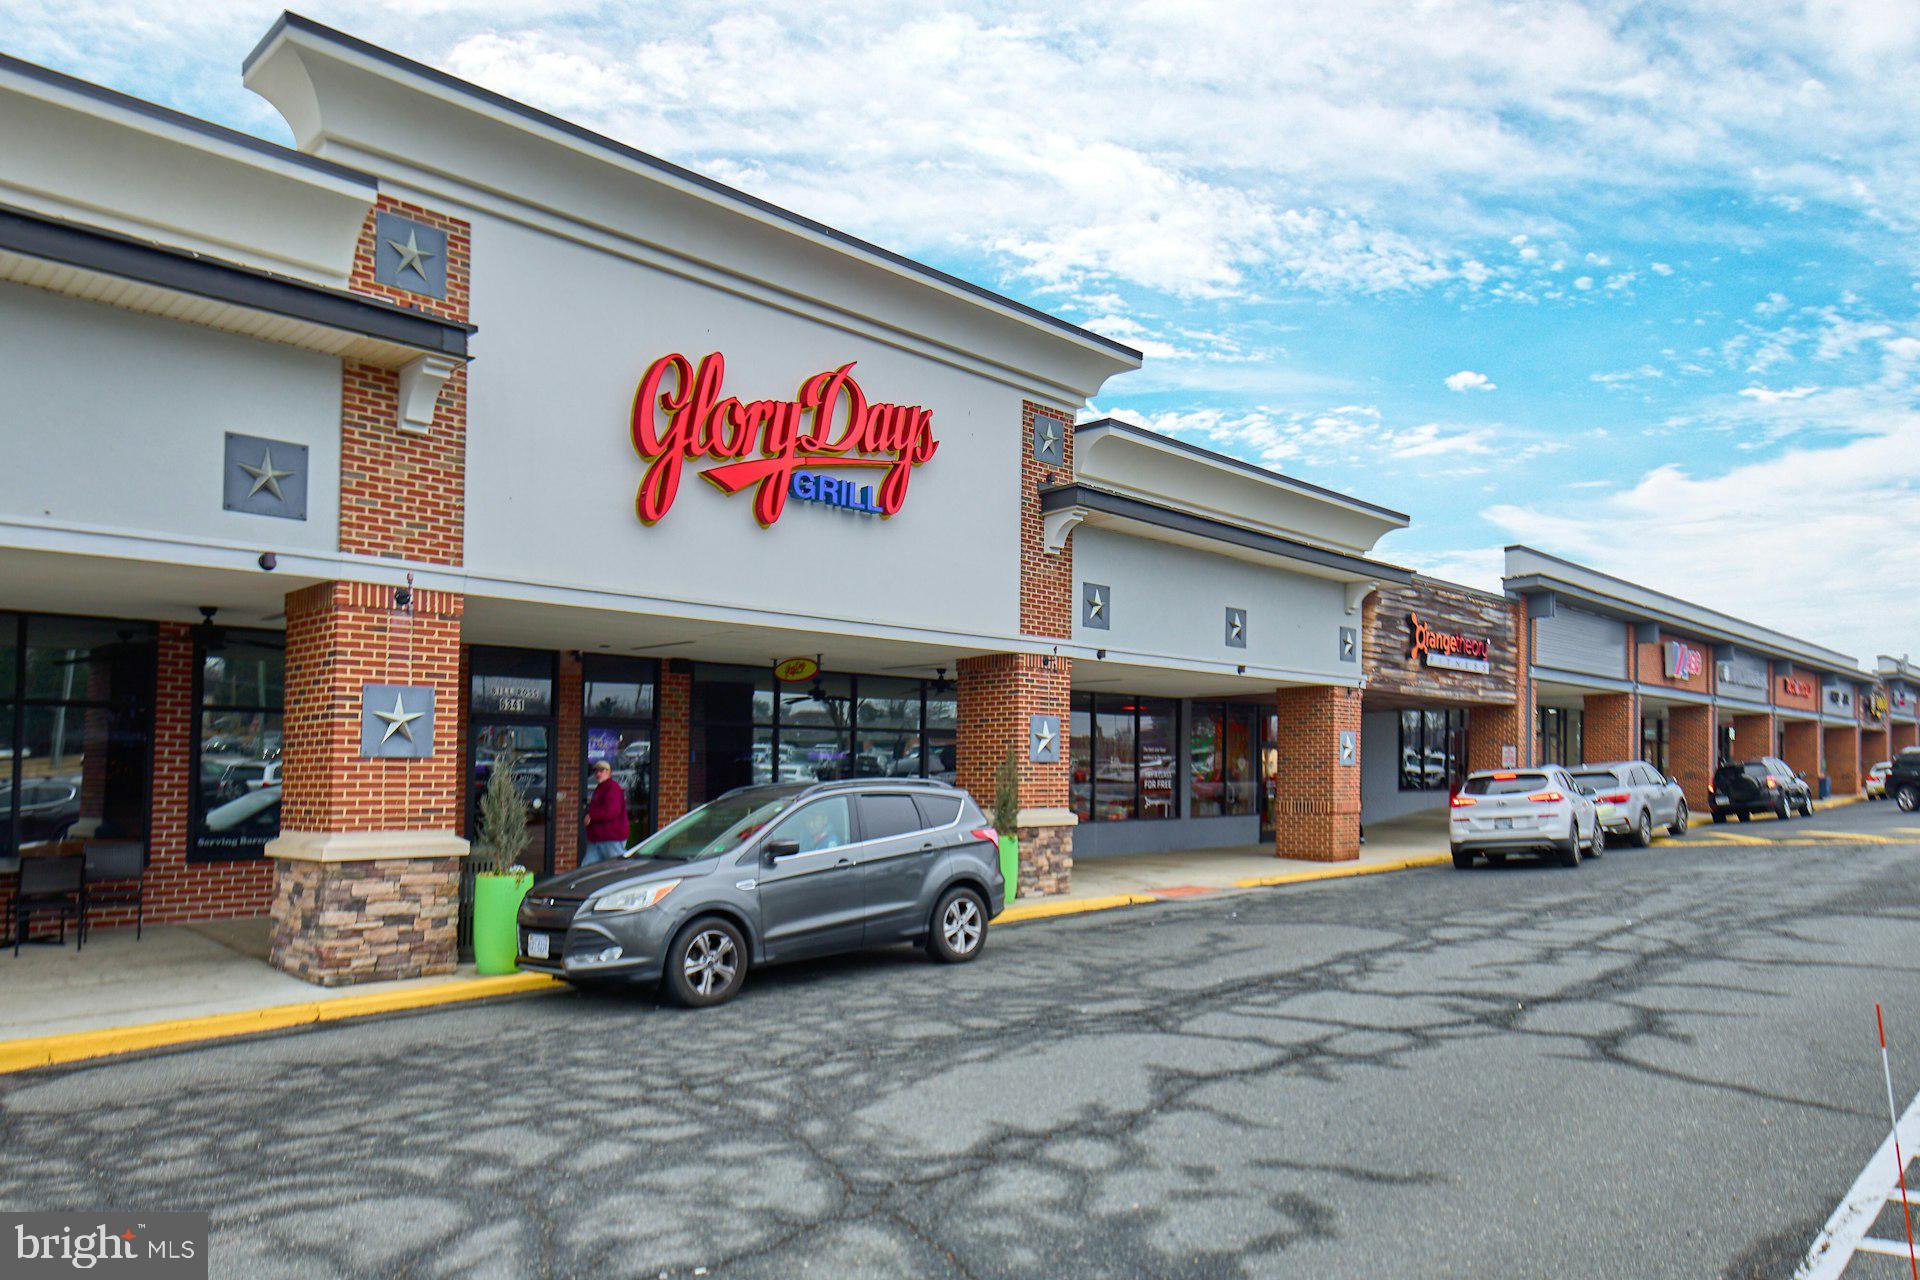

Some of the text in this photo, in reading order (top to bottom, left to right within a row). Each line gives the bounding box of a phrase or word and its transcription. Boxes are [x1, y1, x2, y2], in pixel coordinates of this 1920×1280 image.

[630, 351, 941, 529] Glory Days
[789, 469, 885, 514] GRILL
[1157, 779, 1172, 790] FREE
